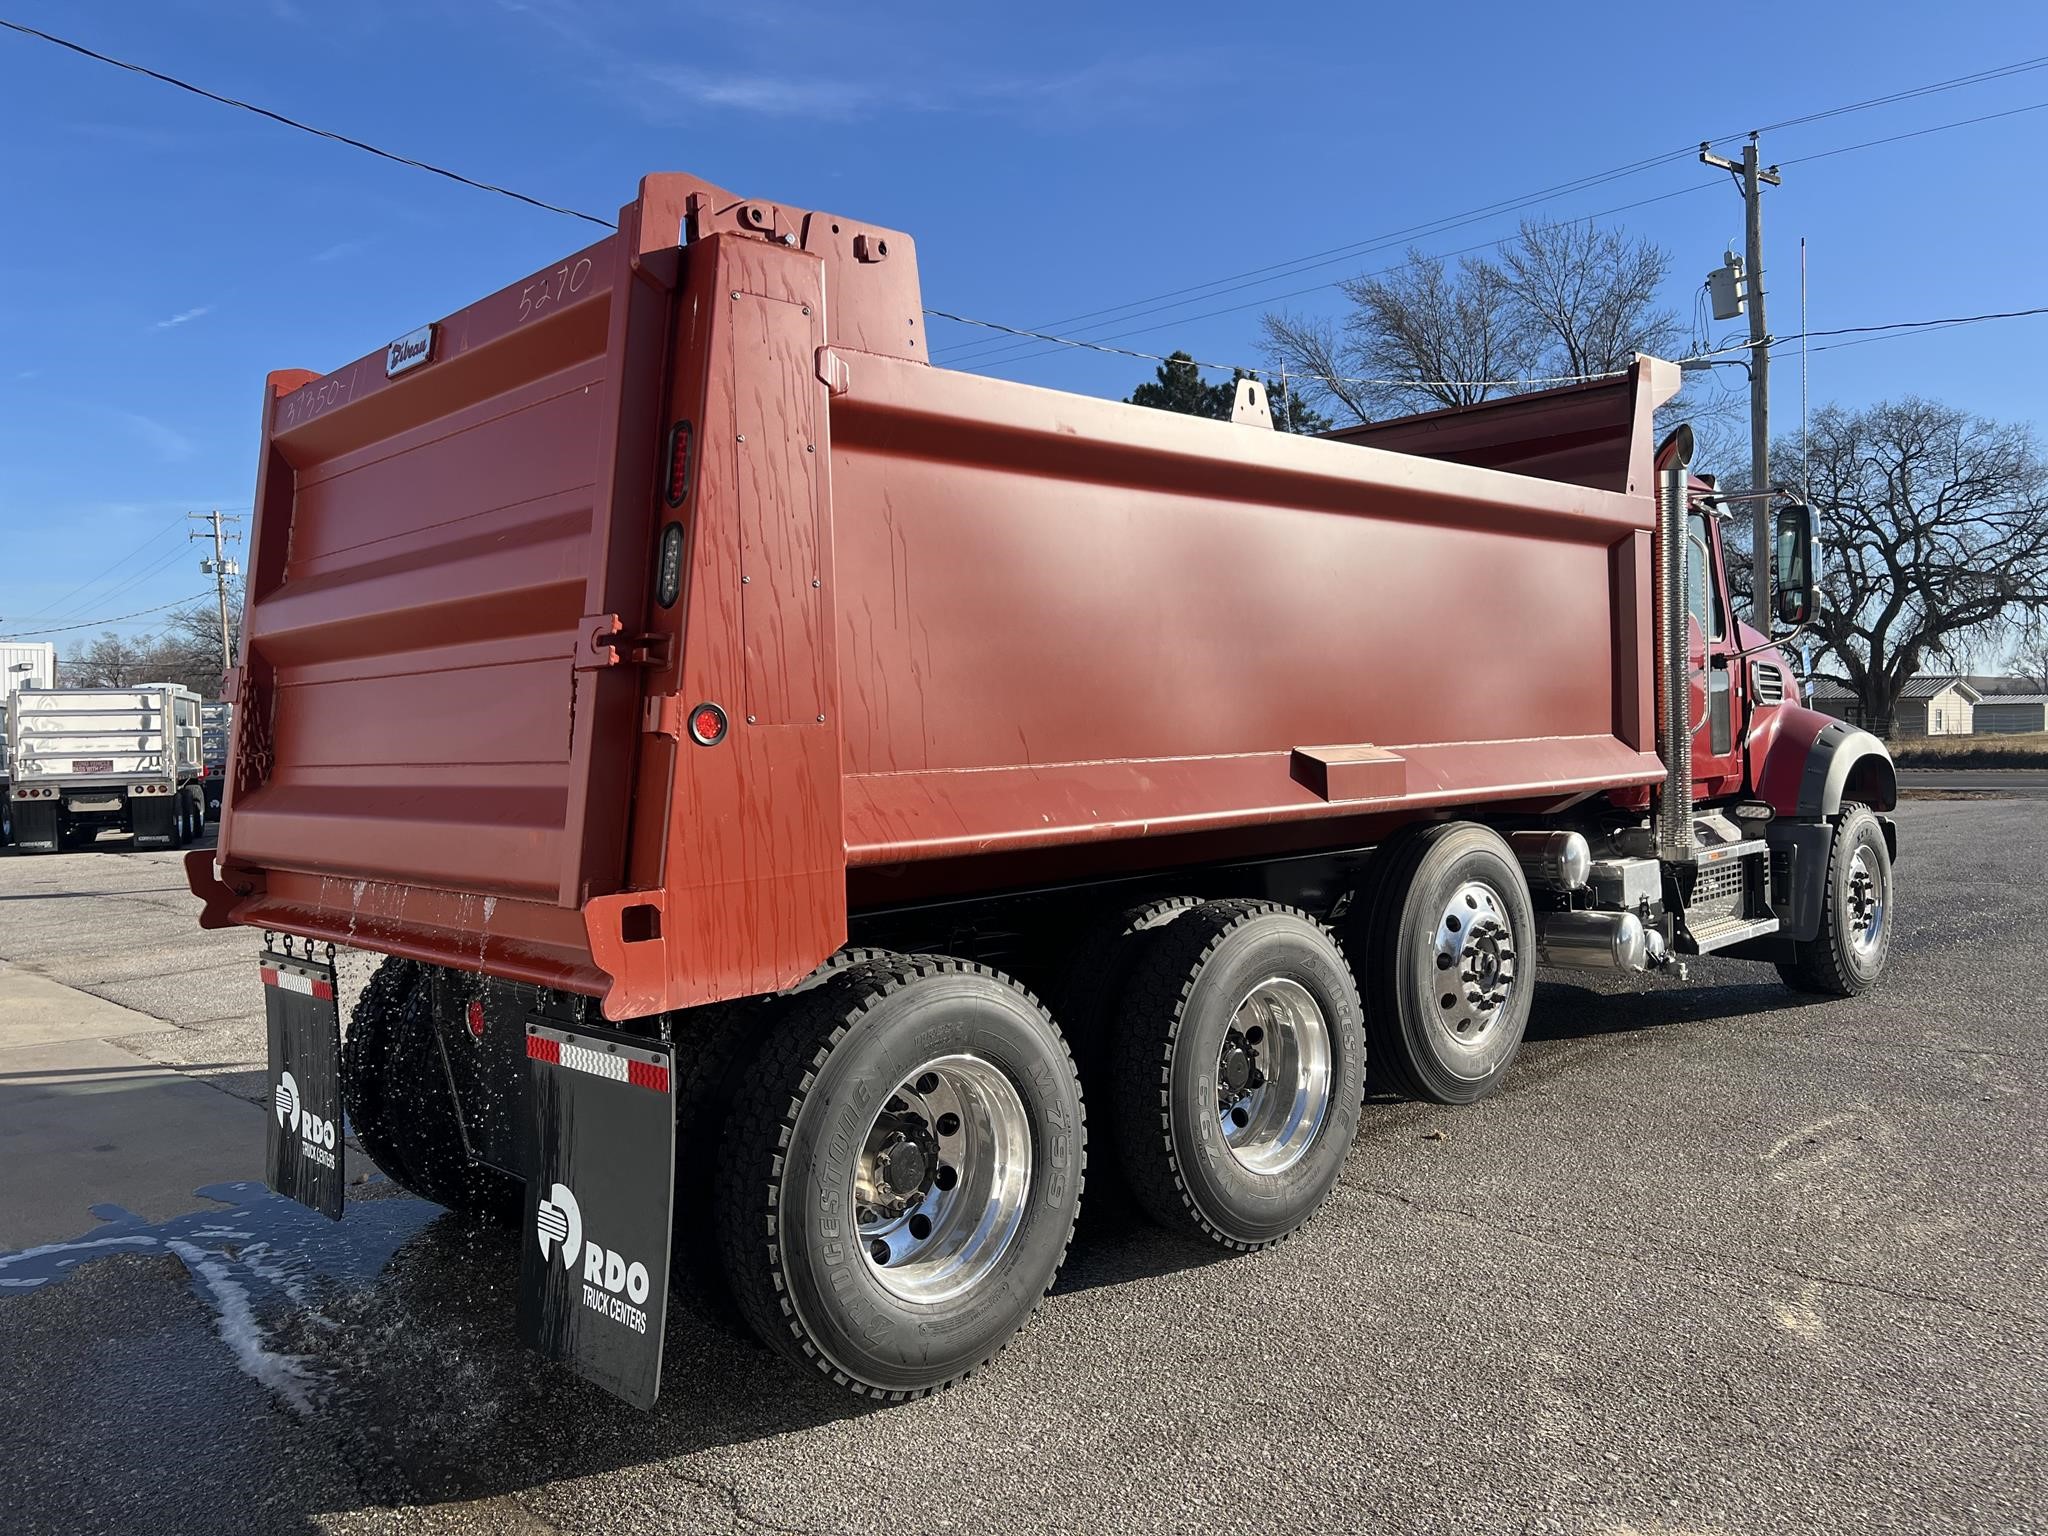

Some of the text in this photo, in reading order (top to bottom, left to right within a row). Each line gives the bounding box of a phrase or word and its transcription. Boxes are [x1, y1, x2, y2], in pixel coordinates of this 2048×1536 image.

[519, 258, 592, 322] 5270
[1299, 952, 1358, 1130] BRIDGESTONE
[302, 1109, 335, 1150] RDO
[1027, 1057, 1069, 1211] M799
[818, 1078, 895, 1346] BRIDGESTONE
[583, 1240, 650, 1305] RDO
[582, 1284, 647, 1335] TRUCK CENTERS
